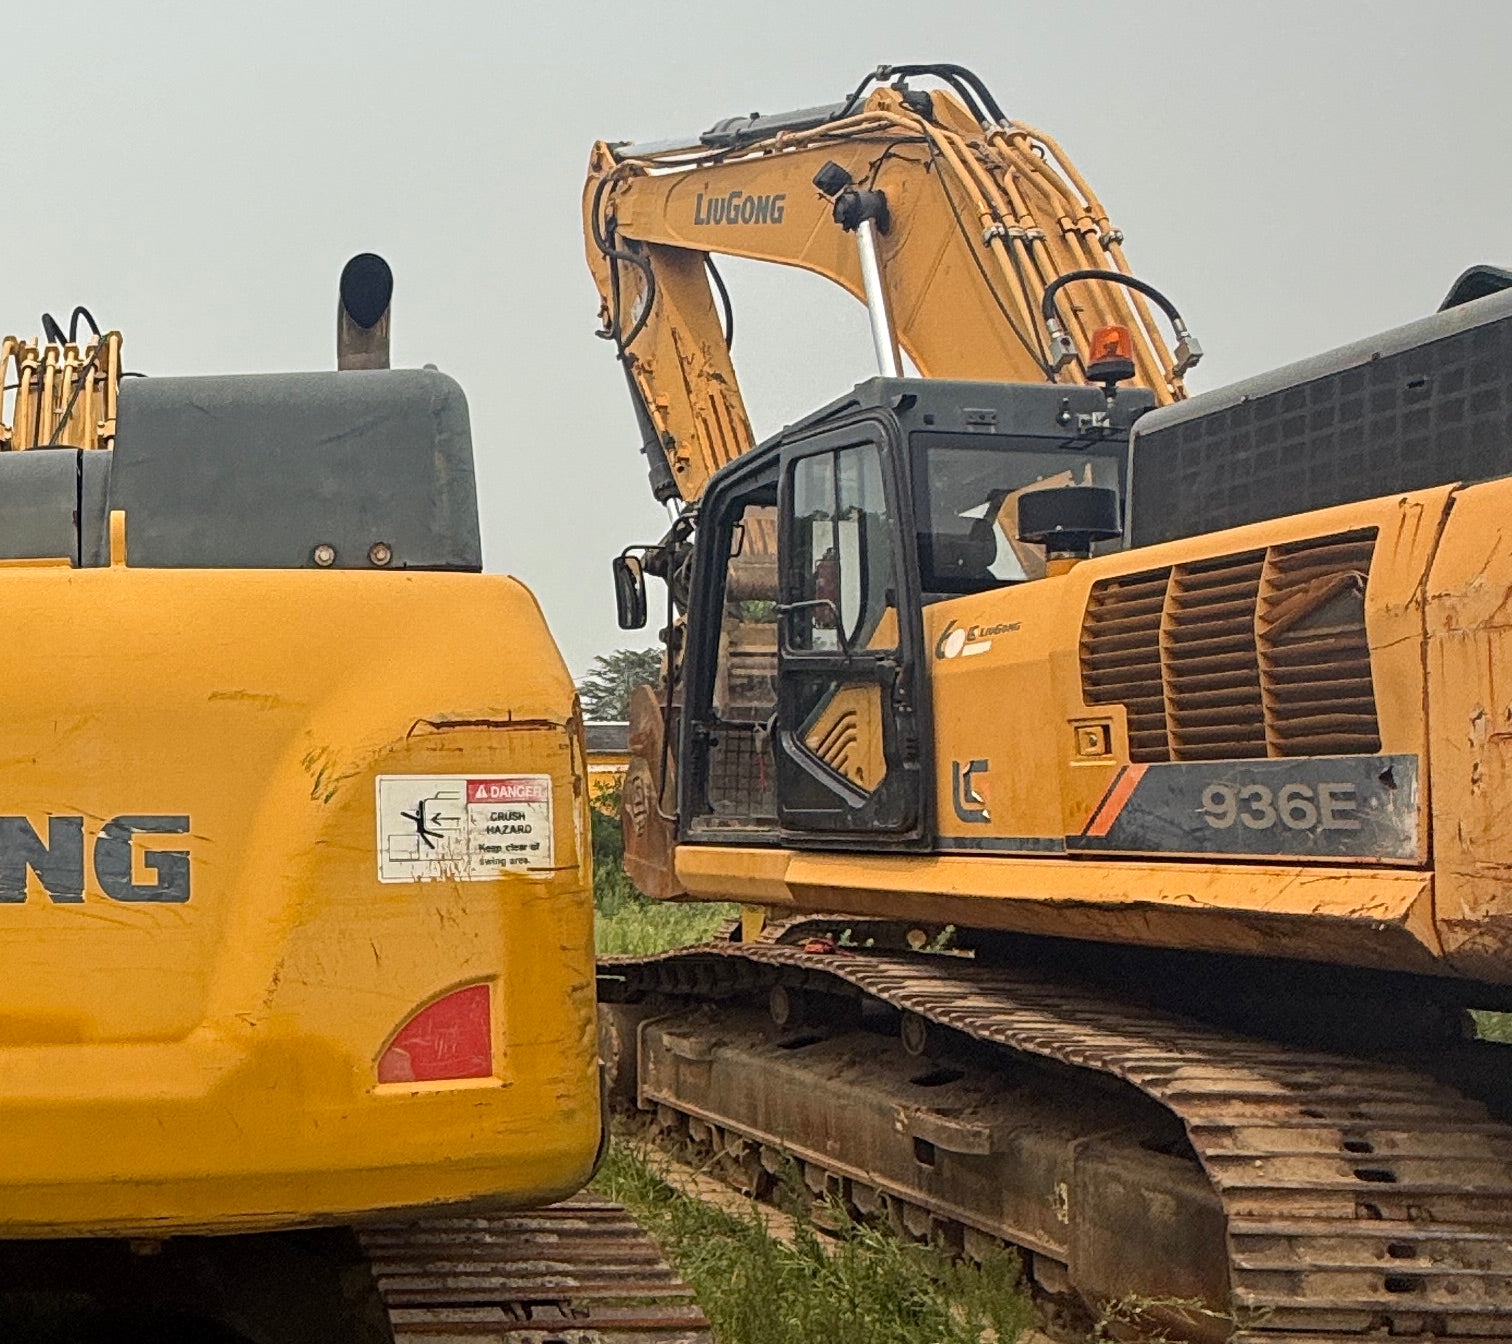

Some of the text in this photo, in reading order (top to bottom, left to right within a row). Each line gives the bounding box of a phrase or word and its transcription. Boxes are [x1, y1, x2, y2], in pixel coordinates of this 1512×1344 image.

[490, 785, 542, 798] DANGER
[1201, 782, 1362, 830] 936E
[490, 811, 526, 822] CRUSH
[486, 824, 533, 835] HAZARD
[478, 842, 540, 854] Keep clear of
[479, 857, 507, 867] swing
